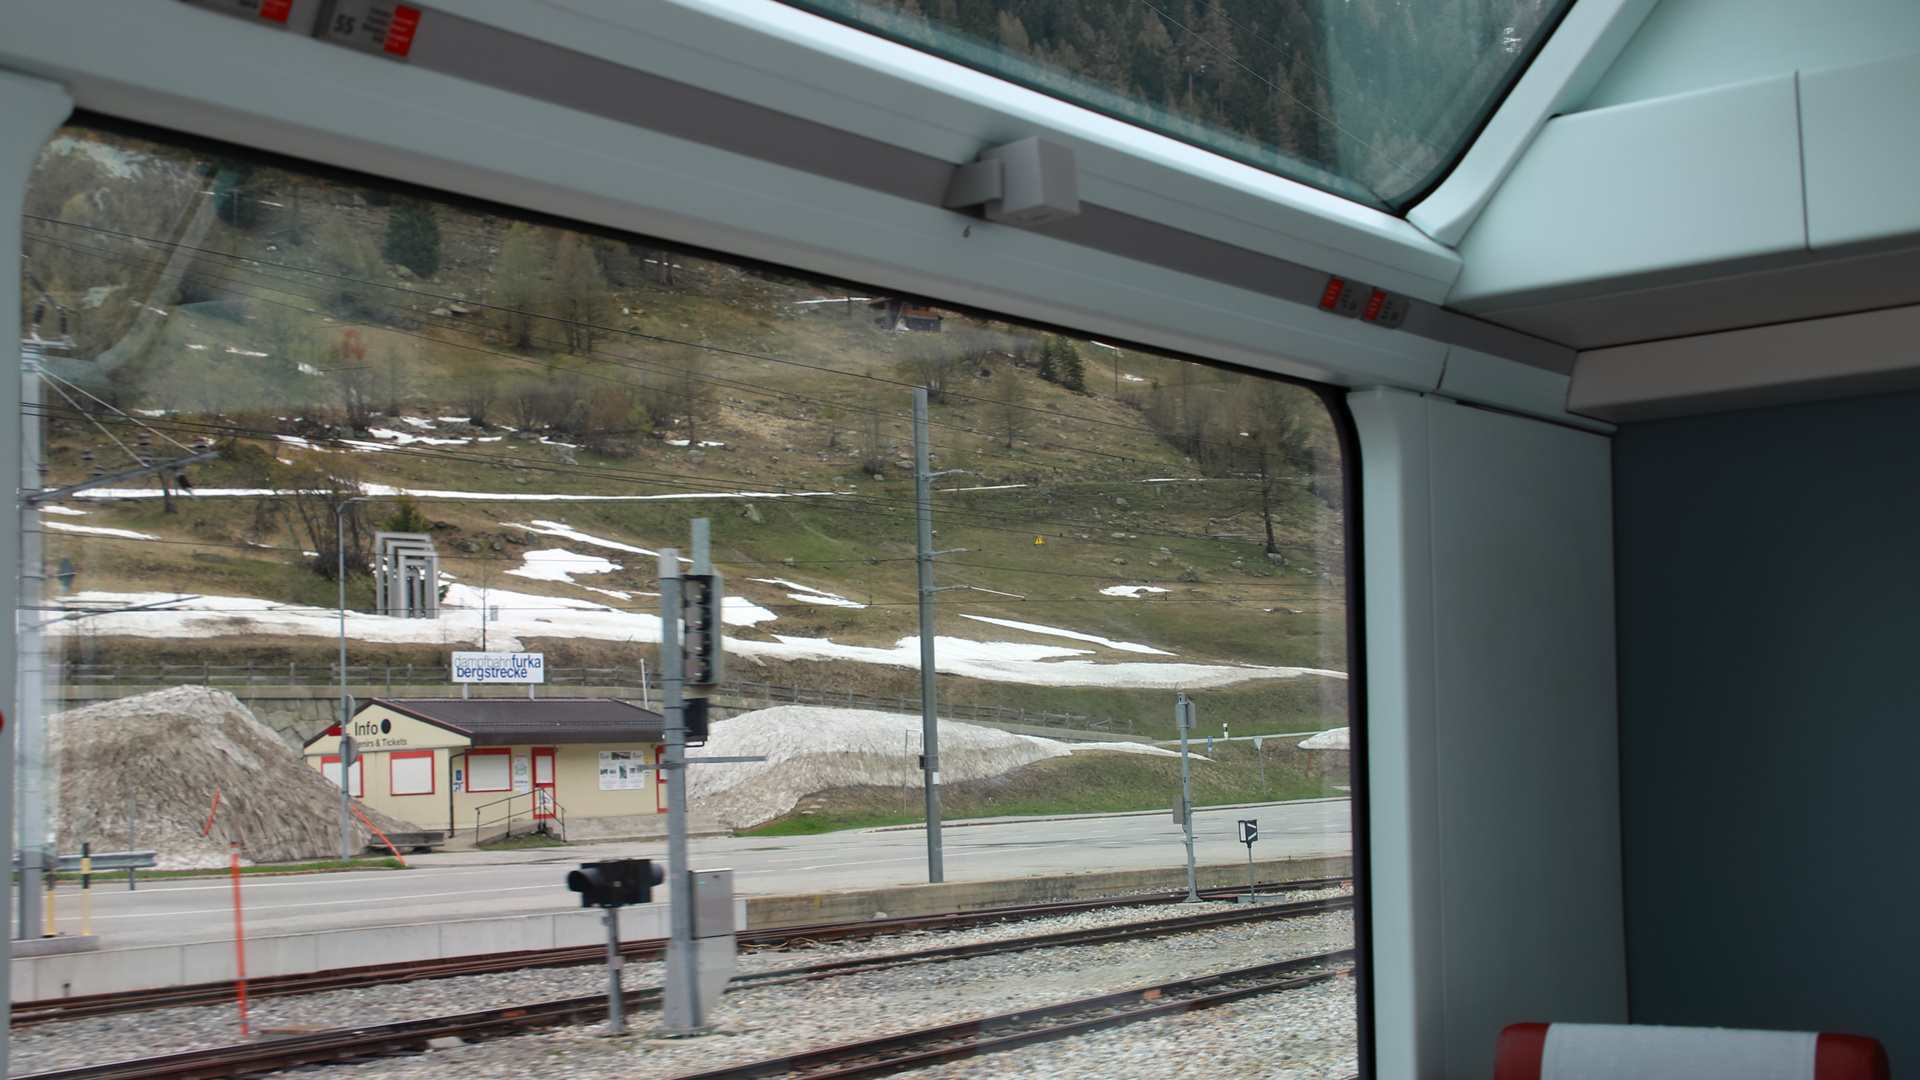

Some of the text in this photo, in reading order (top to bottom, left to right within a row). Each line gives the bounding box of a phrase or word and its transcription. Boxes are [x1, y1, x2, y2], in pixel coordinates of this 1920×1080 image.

[334, 14, 355, 34] 55
[456, 666, 528, 681] bergstrecke
[354, 721, 379, 736] Info
[375, 739, 381, 748] &
[382, 738, 407, 747] Tickets
